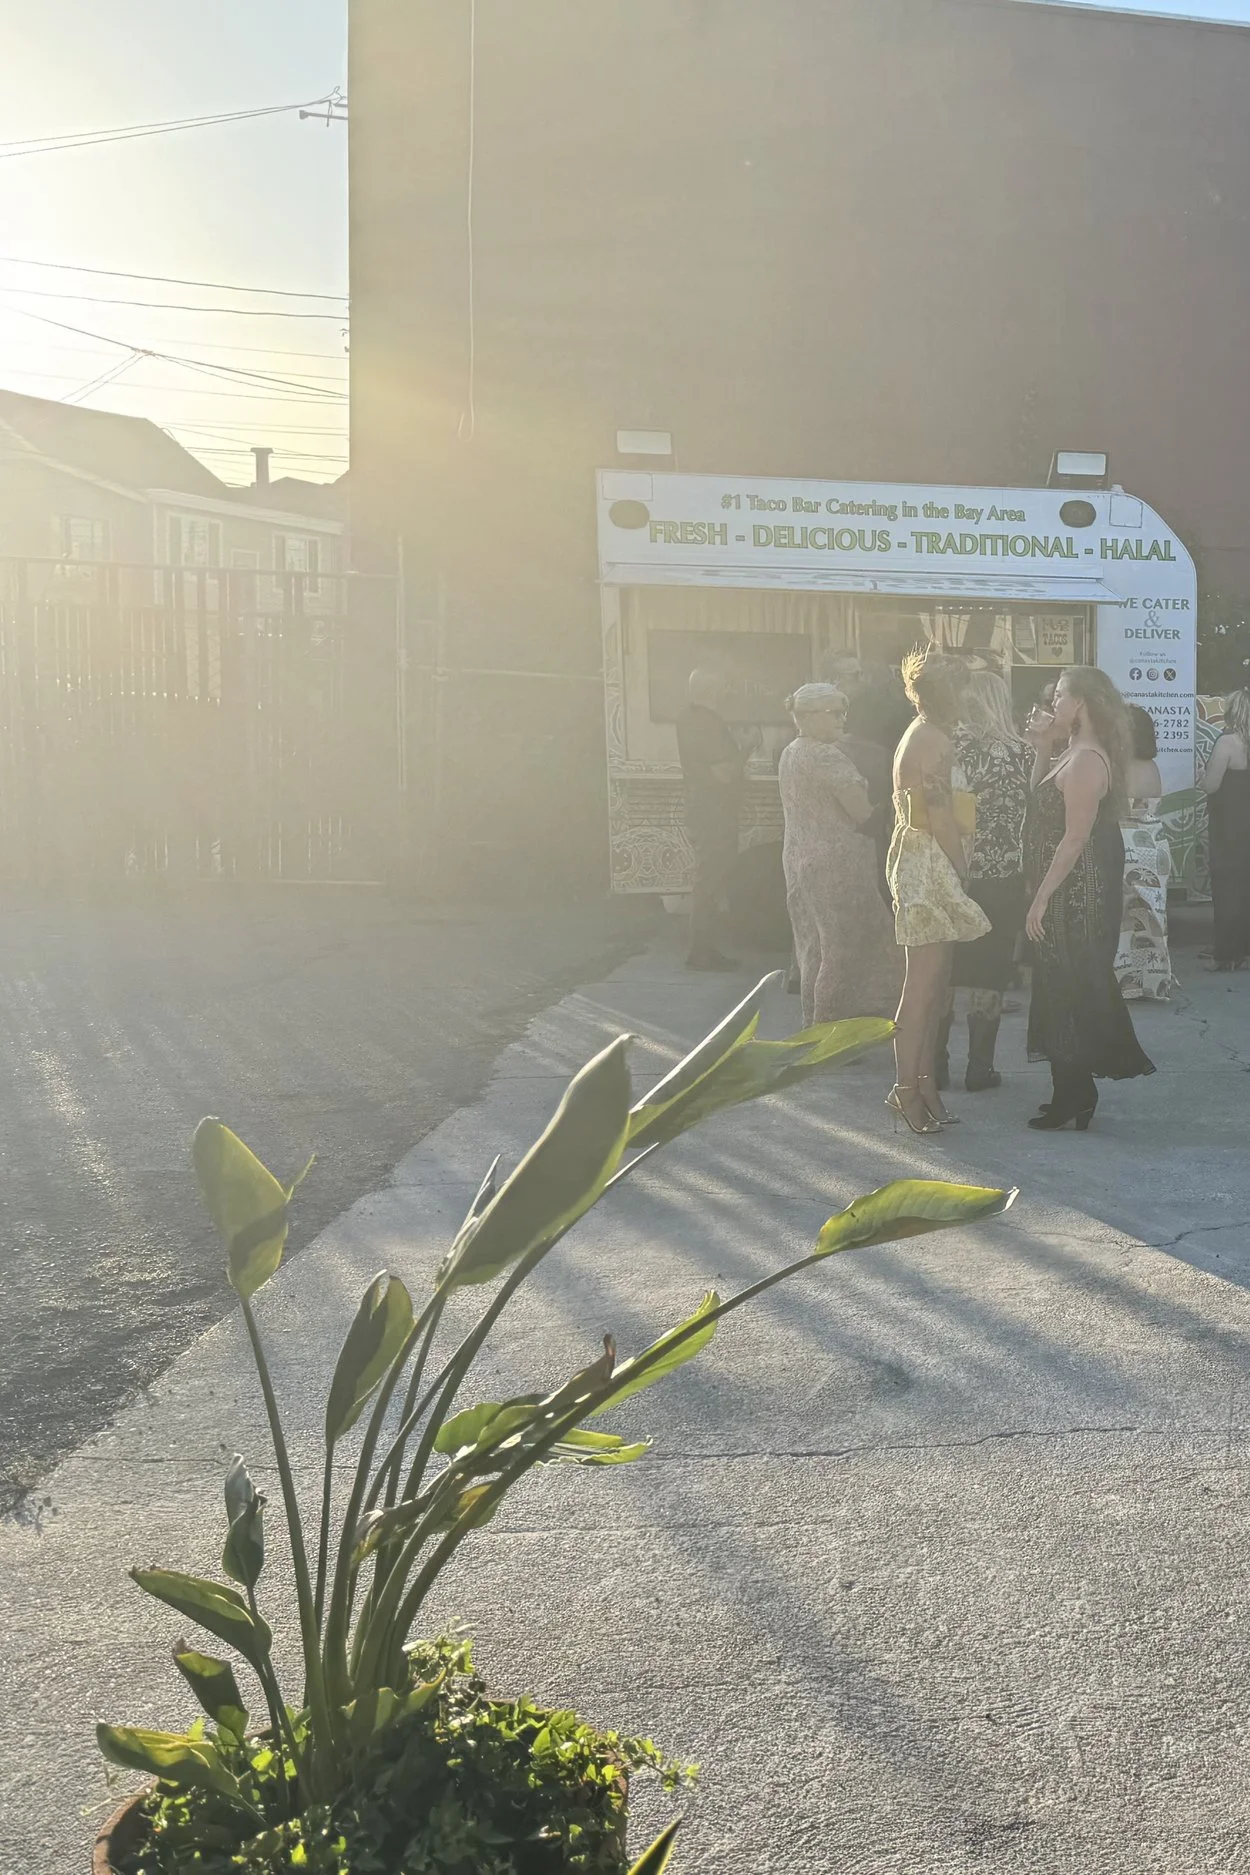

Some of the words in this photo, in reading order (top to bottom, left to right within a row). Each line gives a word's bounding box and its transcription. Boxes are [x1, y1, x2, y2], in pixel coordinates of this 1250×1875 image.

[721, 493, 741, 510] #1
[747, 494, 787, 512] Taco
[792, 496, 821, 514] Bar
[826, 498, 898, 521] Catering
[902, 501, 918, 518] in
[922, 502, 949, 519] the
[954, 504, 984, 525] Bay
[987, 505, 1026, 522] Area
[649, 520, 728, 545] FRESH
[752, 524, 891, 552] DELICIOUS
[911, 531, 1079, 559] TRADITIONAL
[1100, 537, 1177, 562] HALAL
[1142, 598, 1190, 610] CATER
[1144, 610, 1162, 628] &
[1124, 628, 1181, 640] DELIVER
[1144, 706, 1191, 715] ANASTA
[1153, 719, 1189, 728] 6-2782
[1163, 731, 1189, 740] 2395
